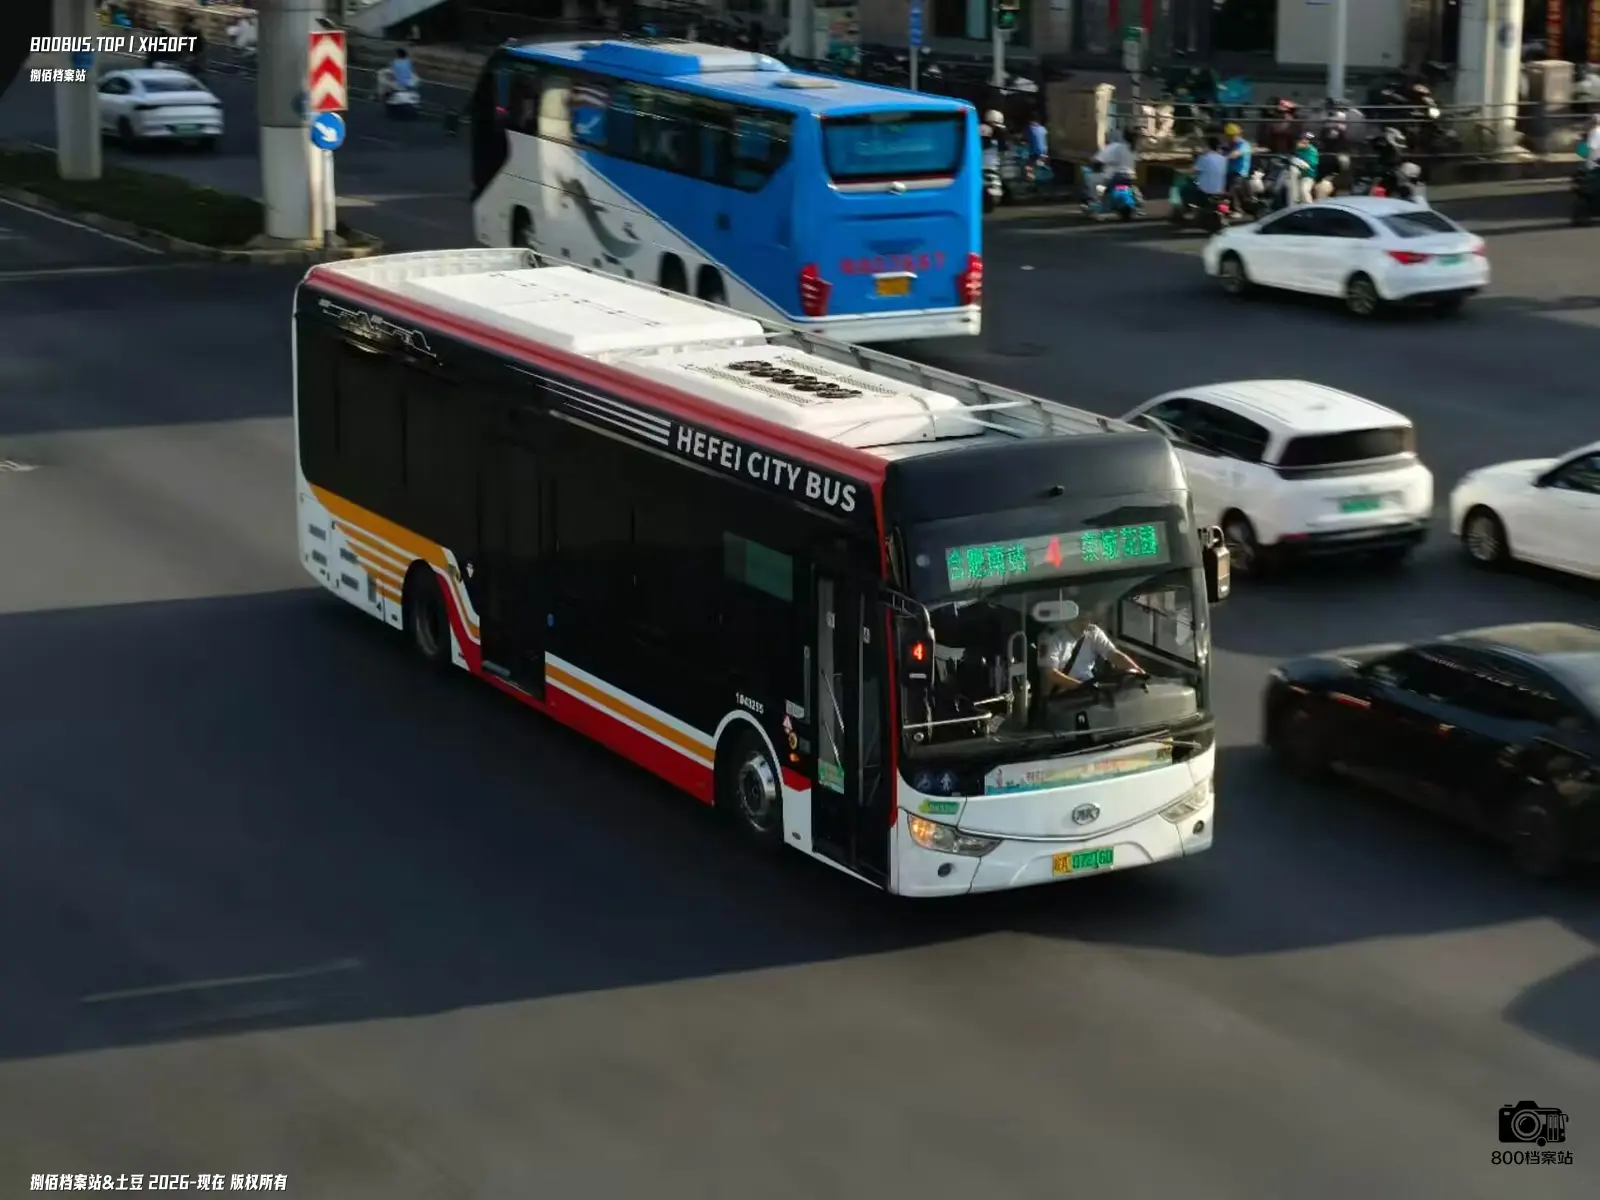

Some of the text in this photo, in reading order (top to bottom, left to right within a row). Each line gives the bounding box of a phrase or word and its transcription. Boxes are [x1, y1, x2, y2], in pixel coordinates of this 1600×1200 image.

[676, 424, 857, 512] HEFEI CITY BUS
[1044, 534, 1063, 569] 4
[911, 641, 924, 661] 4
